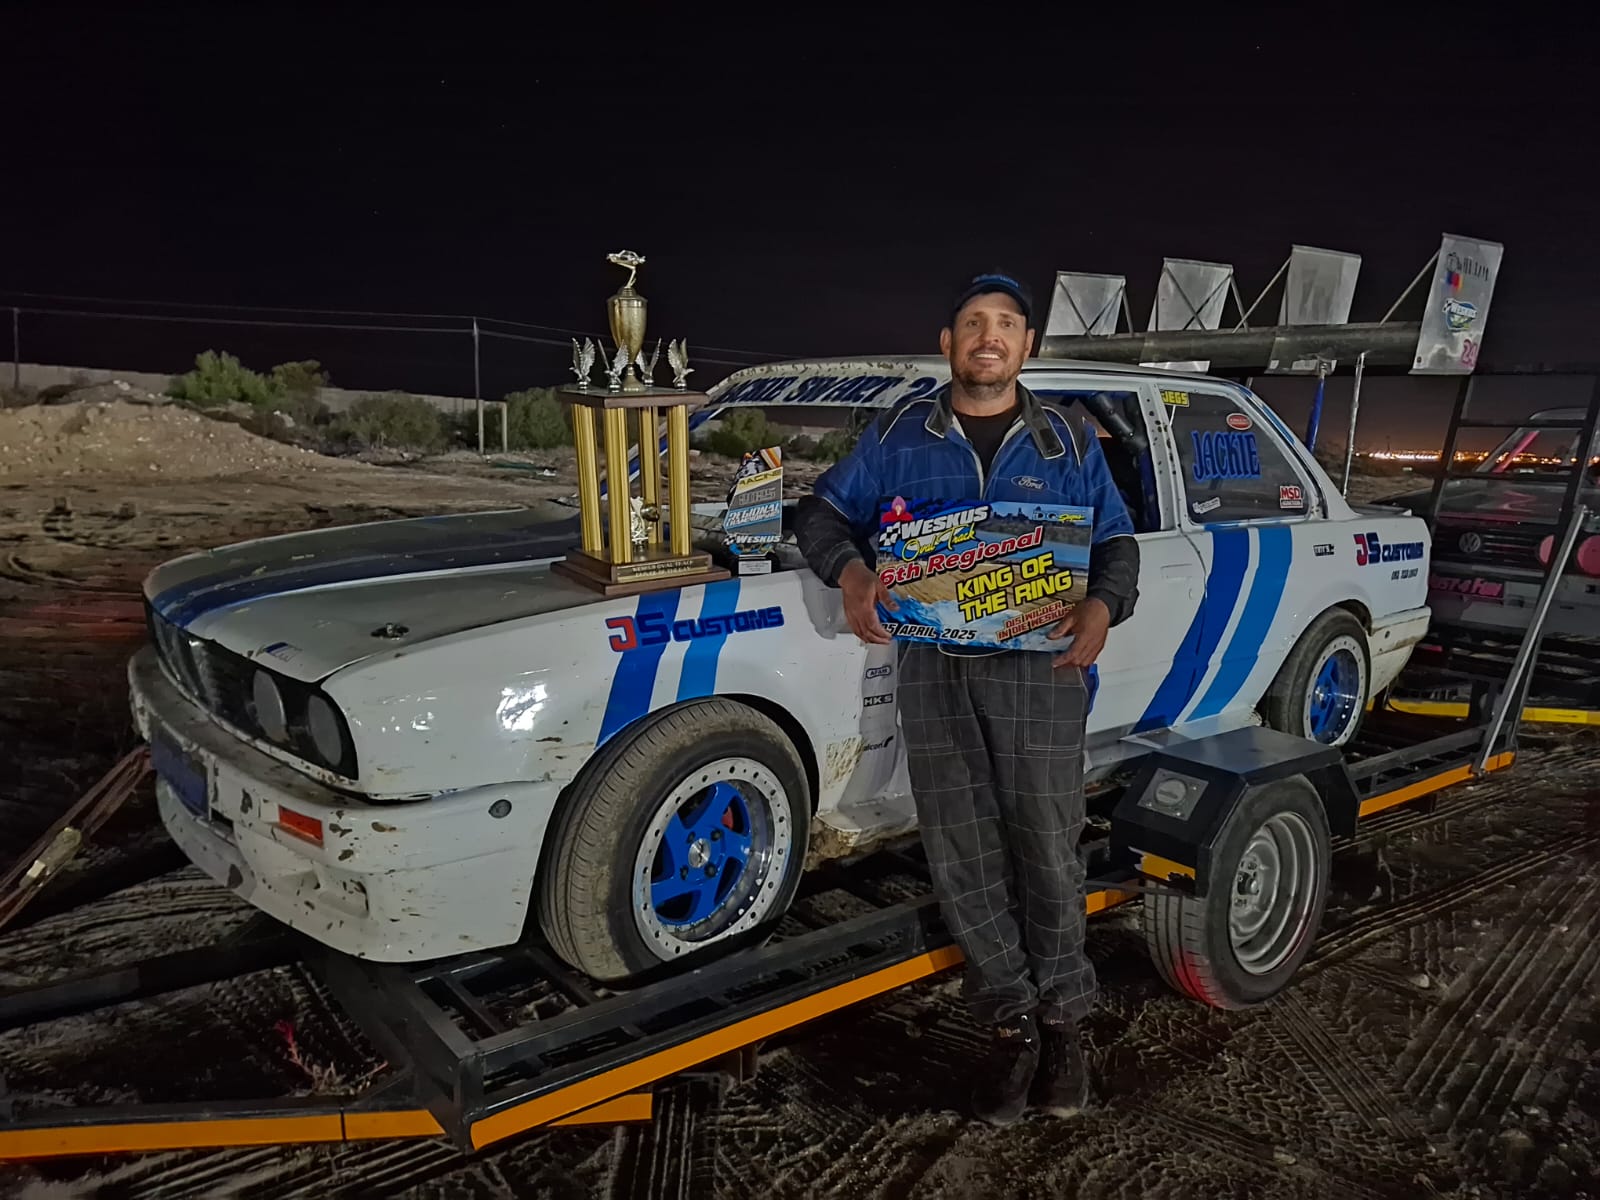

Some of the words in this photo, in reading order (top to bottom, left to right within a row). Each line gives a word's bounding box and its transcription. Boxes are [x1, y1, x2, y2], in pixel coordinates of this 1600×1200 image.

[1161, 390, 1189, 406] JEGS
[1191, 430, 1263, 482] JACKIE
[1017, 477, 1044, 490] Ford
[1280, 487, 1300, 499] MSD
[901, 505, 990, 540] WESKUS
[736, 534, 781, 544] WESKUS
[901, 537, 936, 562] Oval
[935, 522, 977, 550] Track
[1353, 532, 1381, 566] JS
[1381, 541, 1424, 562] CUSTOMS
[879, 562, 921, 587] 6th
[926, 525, 1043, 575] Regional
[957, 565, 1014, 601] KING
[1021, 553, 1055, 581] OF
[958, 595, 1008, 623] THE
[1015, 570, 1073, 606] RING
[605, 611, 671, 652] JS
[672, 605, 785, 643] CUSTOMS
[1005, 616, 1022, 628] DIS
[1025, 602, 1063, 621] WILDER
[942, 628, 978, 640] 2025
[998, 629, 1010, 639] IN
[1012, 622, 1029, 634] DIE
[864, 694, 892, 706] HKS
